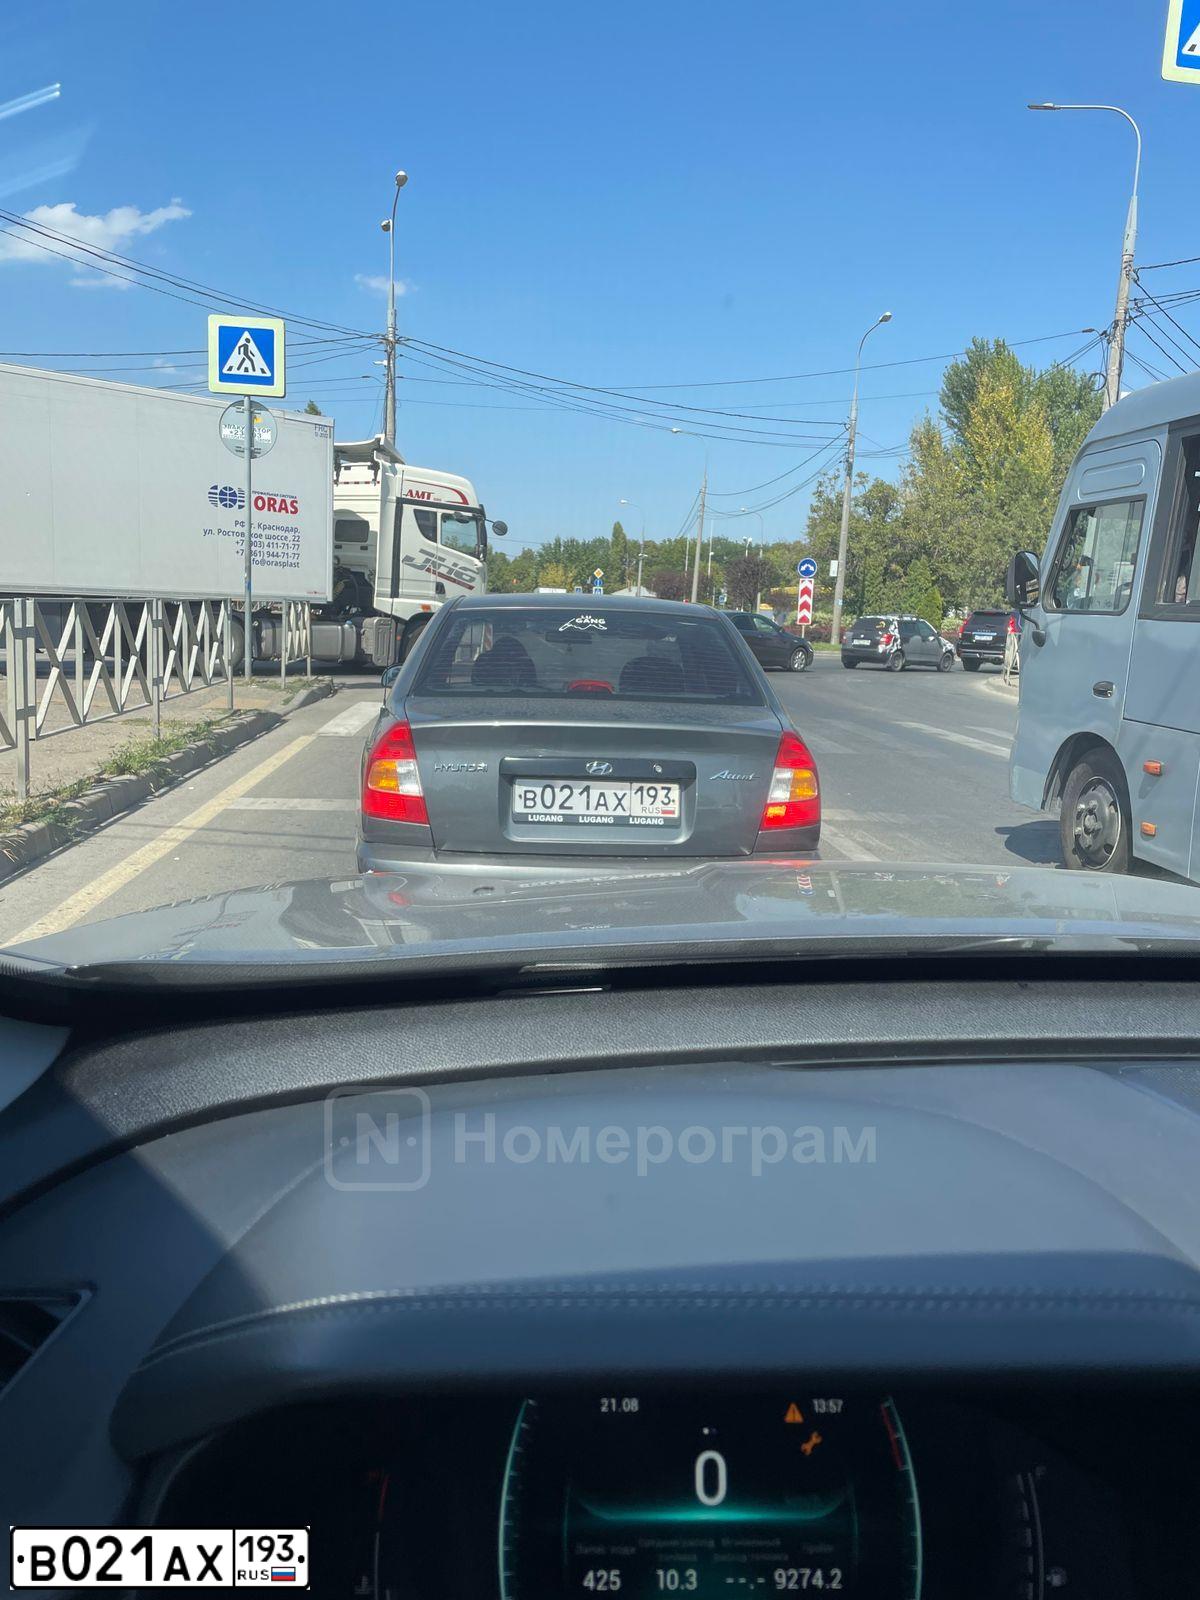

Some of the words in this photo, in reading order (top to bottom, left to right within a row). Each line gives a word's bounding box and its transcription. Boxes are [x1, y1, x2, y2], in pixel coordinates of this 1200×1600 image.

[254, 495, 299, 515] ORAS
[203, 528, 215, 536] ул.
[217, 529, 263, 540] Ростовкое
[265, 534, 291, 542] шоссе,
[292, 535, 301, 543] 22
[257, 523, 301, 535] Краснодар,
[266, 542, 301, 551] 411-71-77
[266, 551, 301, 560] 944-71-77
[634, 785, 672, 806] 193
[641, 806, 661, 814] RUS
[528, 814, 564, 823] LUGANG
[578, 815, 614, 824] LUGANG
[629, 816, 665, 825] LUGANG
[600, 1398, 640, 1413] 21.08
[813, 1399, 844, 1414] 13:57
[695, 1450, 727, 1506] 0
[582, 1569, 622, 1591] 425
[656, 1568, 698, 1590] 10.3
[774, 1568, 842, 1590] 9274.2
